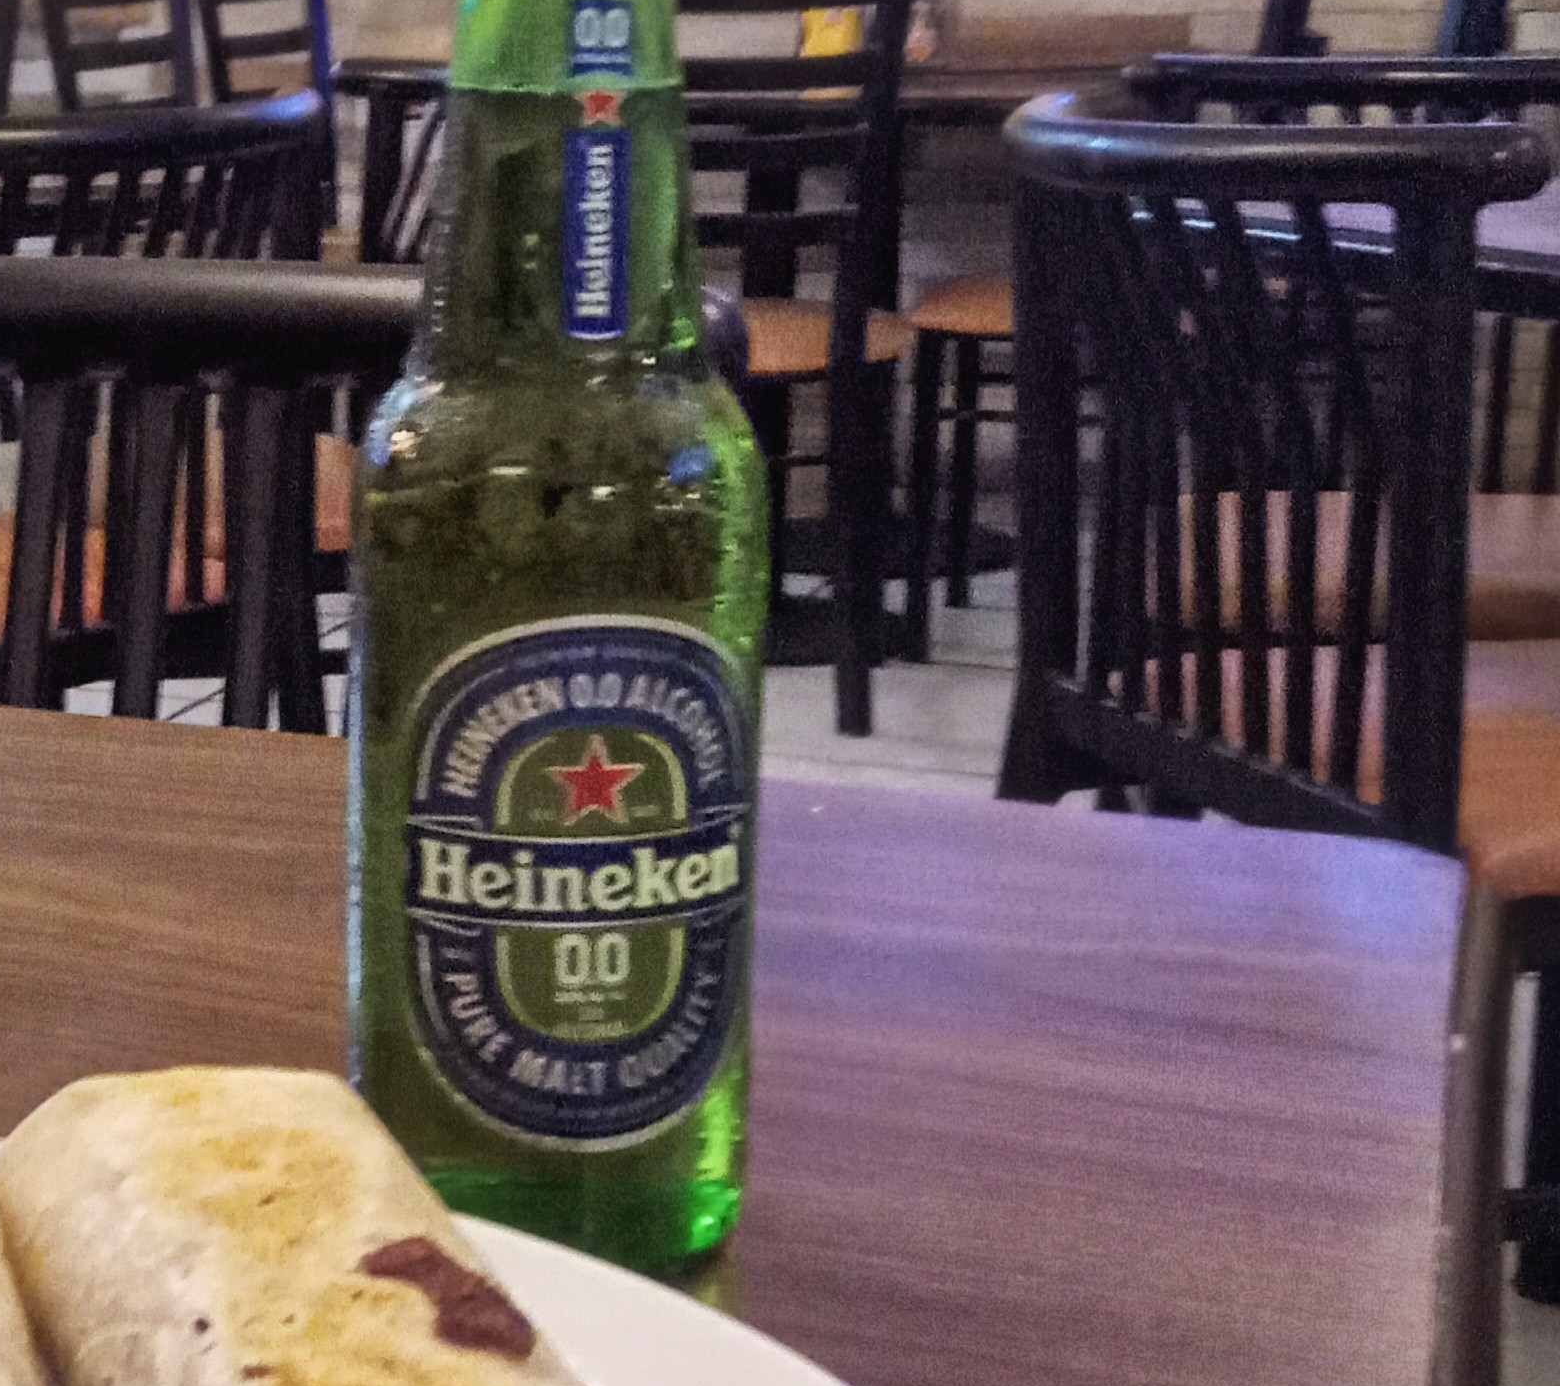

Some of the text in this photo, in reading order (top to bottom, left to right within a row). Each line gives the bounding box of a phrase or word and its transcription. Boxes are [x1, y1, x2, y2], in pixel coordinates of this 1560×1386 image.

[574, 143, 614, 319] Heineken
[418, 836, 740, 913] Heineken
[443, 971, 513, 1062] PURE
[509, 1048, 608, 1096] MALT
